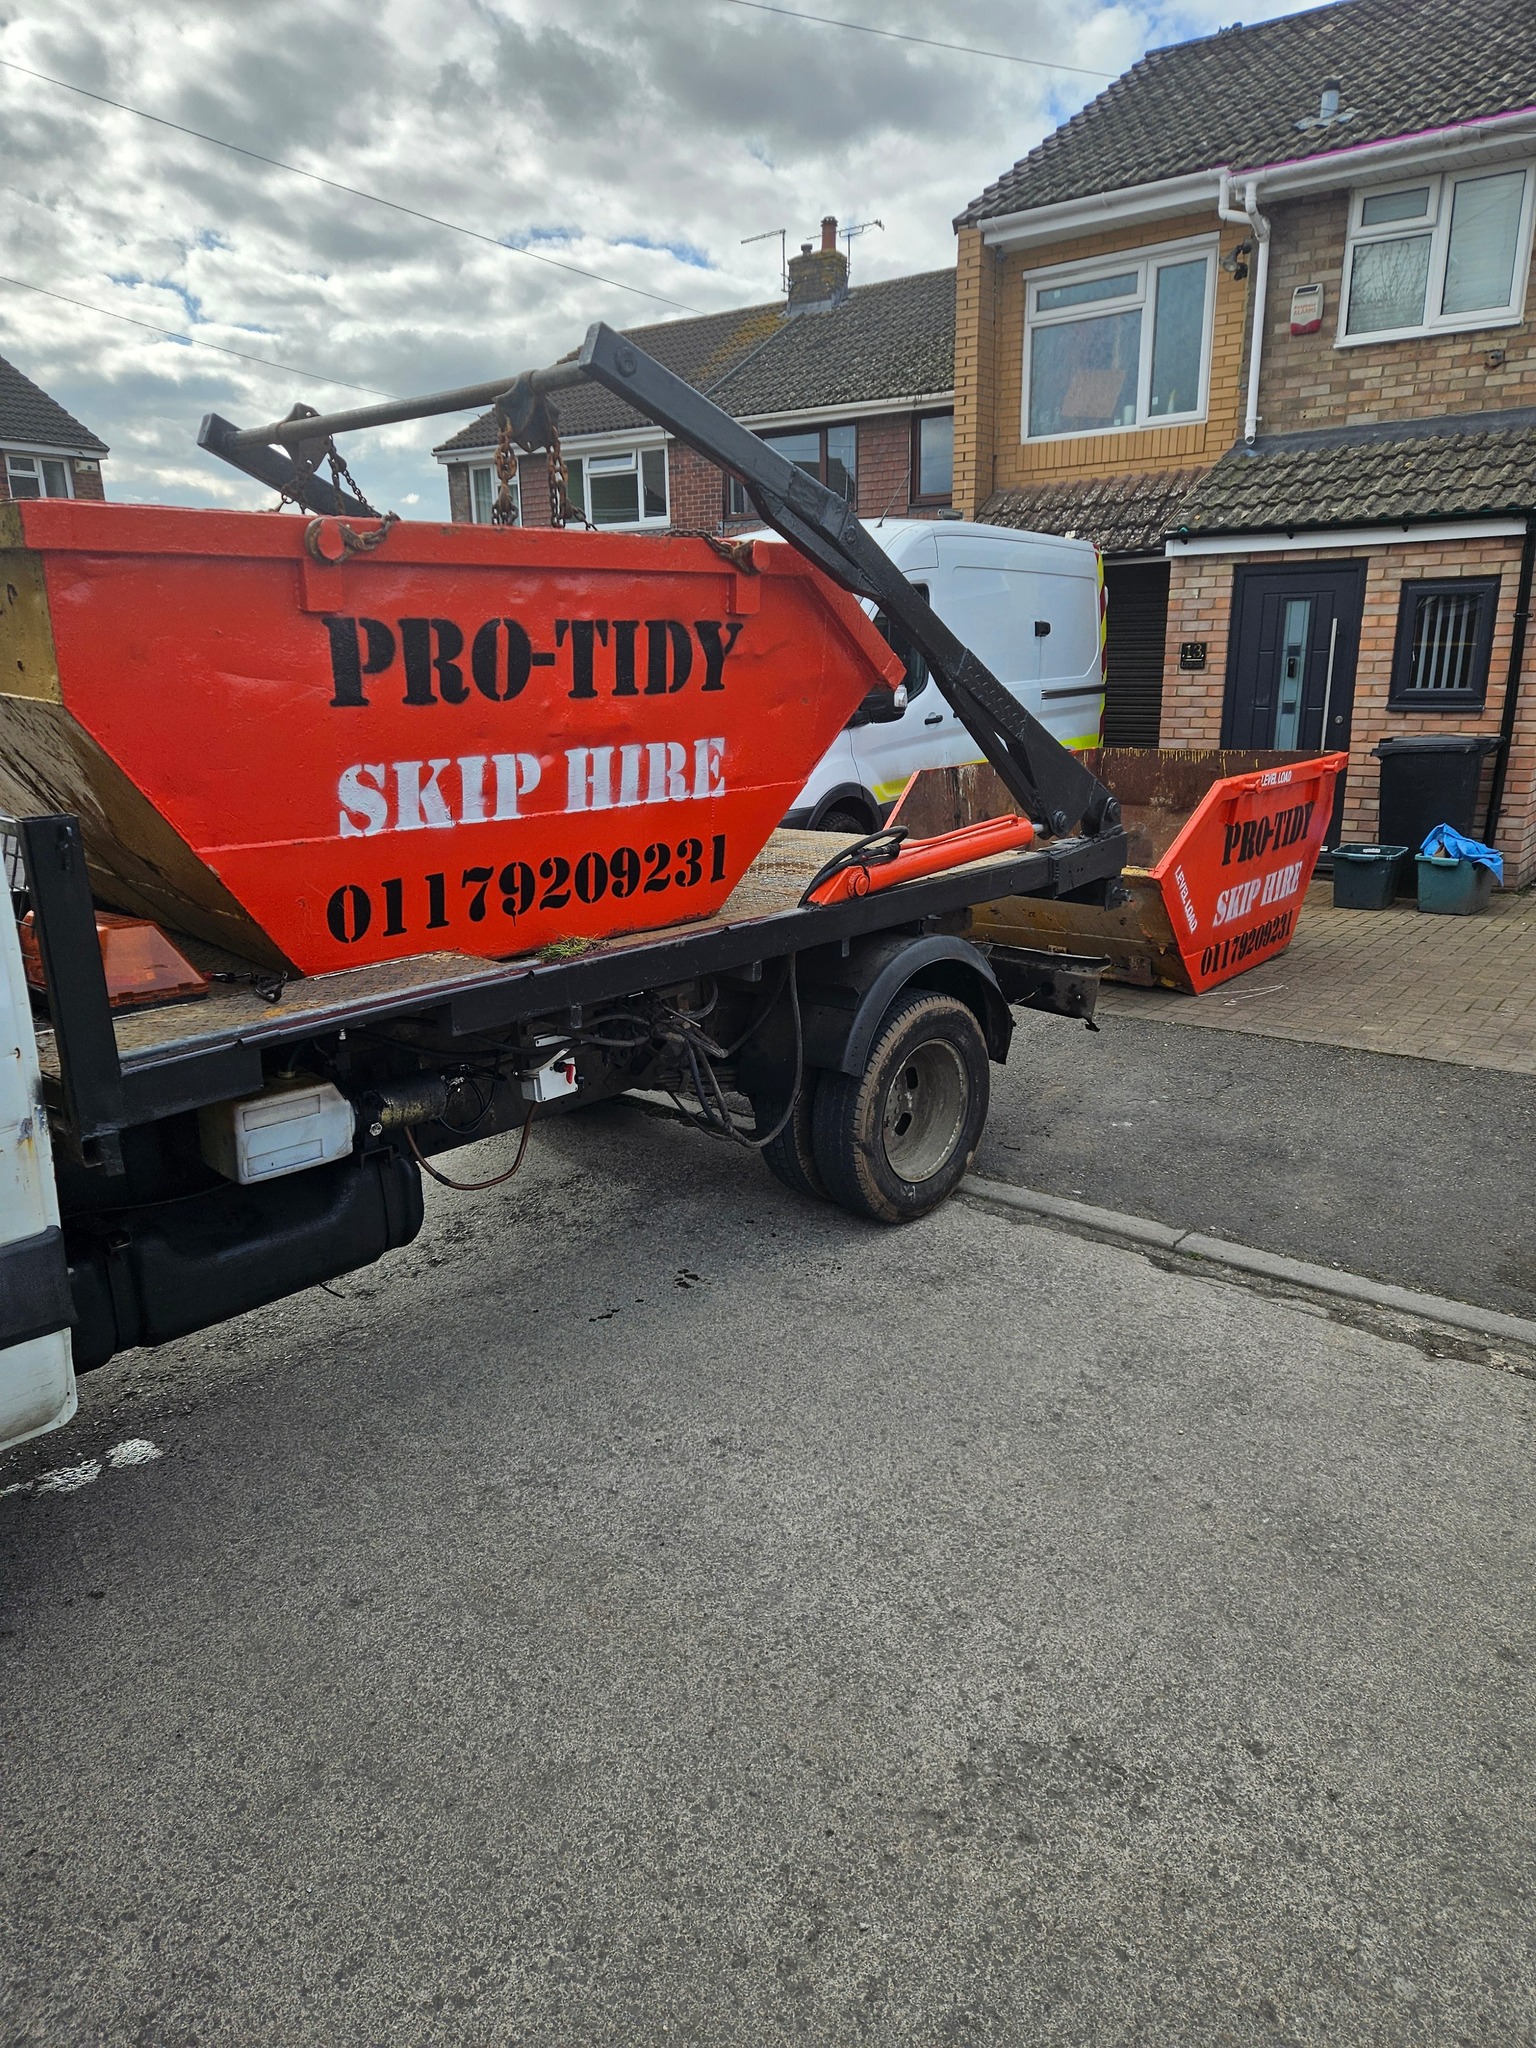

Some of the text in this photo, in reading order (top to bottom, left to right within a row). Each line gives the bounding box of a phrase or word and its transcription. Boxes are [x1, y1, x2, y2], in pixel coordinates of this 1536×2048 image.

[322, 617, 743, 707] PRO-TIDY
[1186, 644, 1202, 658] 13
[338, 737, 725, 838] SKIP HIRE
[1261, 770, 1292, 787] LEVEL LOAD
[1222, 801, 1315, 866] PRO-TIDY
[327, 834, 726, 944] 01179209231
[1175, 864, 1198, 934] LEVEL LOAD
[1212, 861, 1303, 928] SKIP HIRE
[1201, 909, 1294, 977] 01179209231
